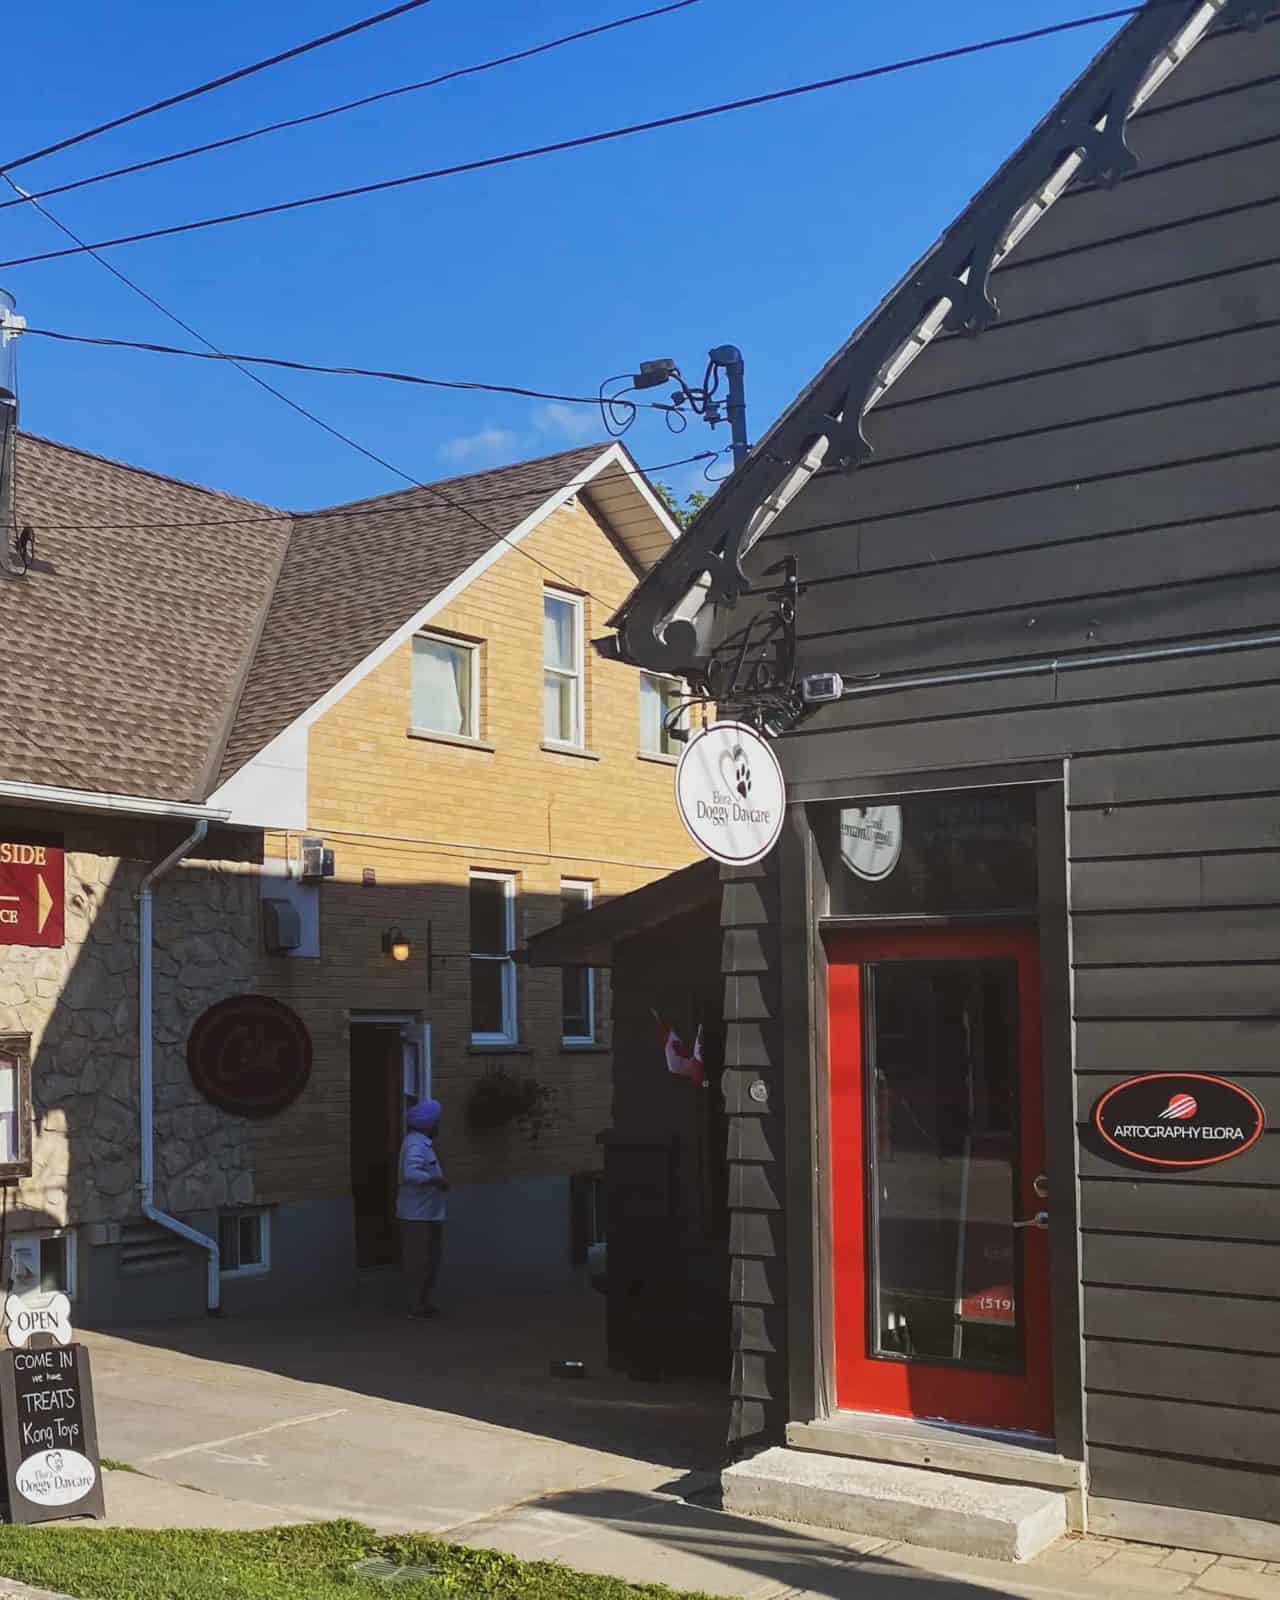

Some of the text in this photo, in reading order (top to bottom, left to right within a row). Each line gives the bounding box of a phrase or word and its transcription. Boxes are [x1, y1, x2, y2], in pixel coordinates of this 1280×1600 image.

[696, 800, 770, 826] Doggy Daycare
[1114, 1125, 1244, 1140] ARTOGRAPHY ELORA
[17, 1311, 59, 1332] OPEN
[15, 1351, 73, 1371] COME IN
[31, 1373, 43, 1384] we
[22, 1388, 75, 1413] TREATS
[23, 1417, 79, 1449] Kong Toys
